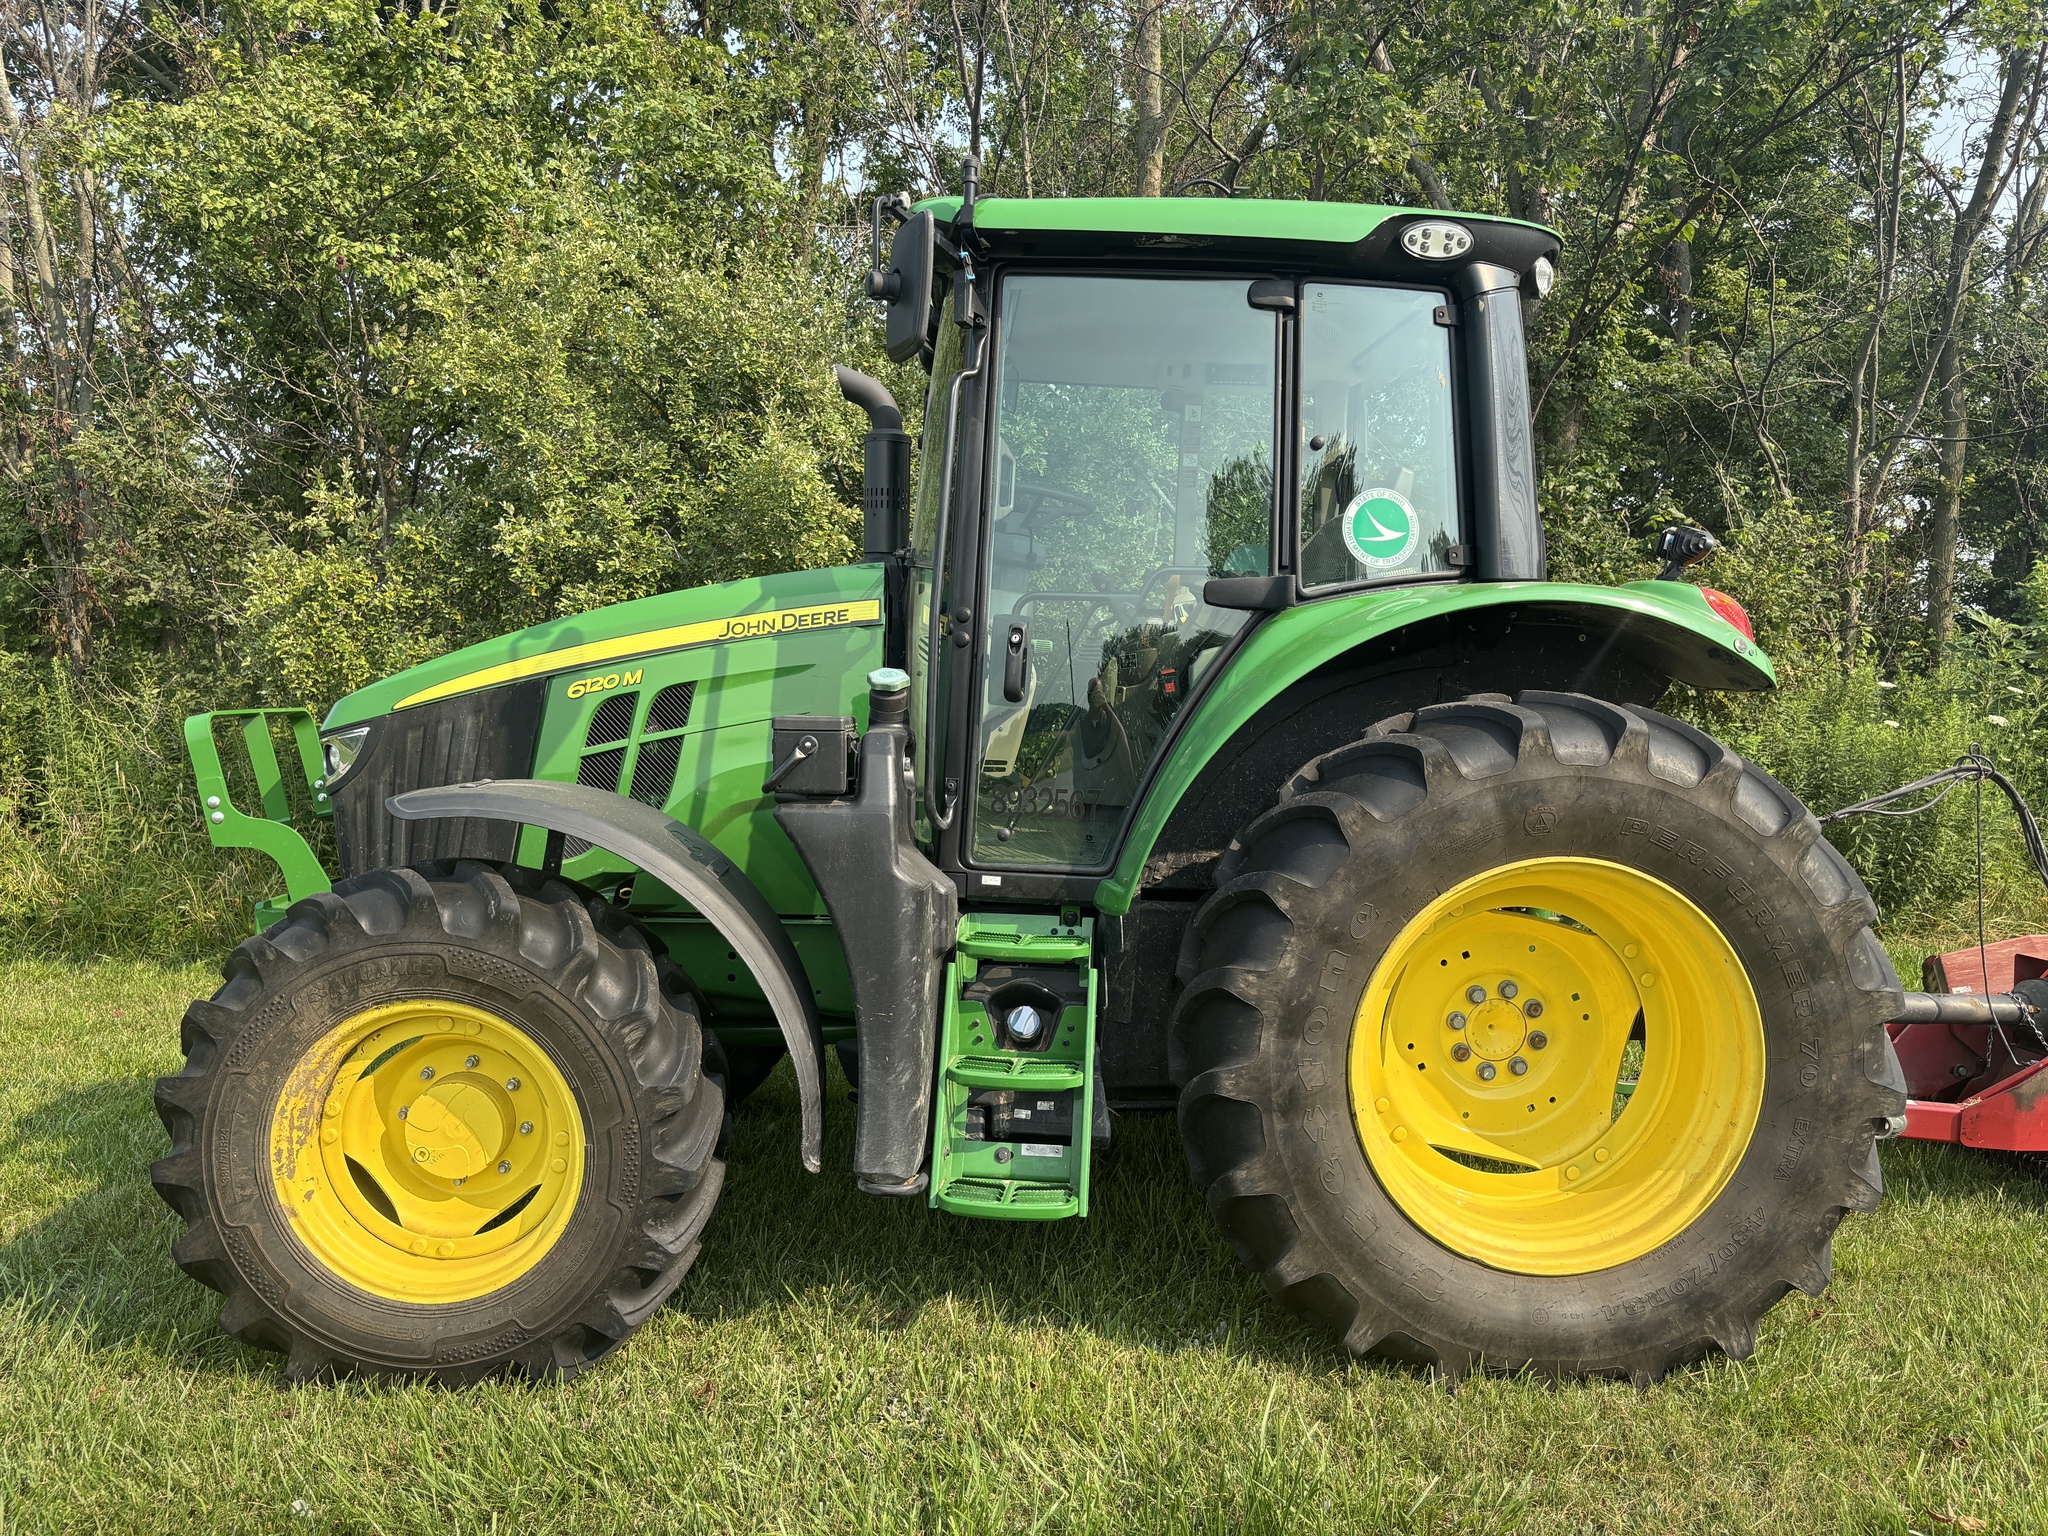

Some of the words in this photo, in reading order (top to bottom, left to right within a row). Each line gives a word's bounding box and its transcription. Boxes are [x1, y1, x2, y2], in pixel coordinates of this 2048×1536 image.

[1354, 491, 1376, 508] STATE
[1388, 492, 1406, 508] OHIO
[1345, 516, 1369, 561] DEPARTMENT
[1370, 557, 1380, 565] OF
[1381, 515, 1417, 565] TRANSPORTATION
[719, 616, 778, 639] JOHN
[781, 609, 850, 633] DEERE
[566, 674, 621, 700] 6120
[622, 668, 644, 688] M
[990, 784, 1102, 821] 8932567
[1620, 816, 1817, 1018] PERFORMER
[1800, 1037, 1821, 1088] 70
[1773, 1116, 1812, 1182] EXTRA
[1600, 1206, 1767, 1322] 480/70R34
